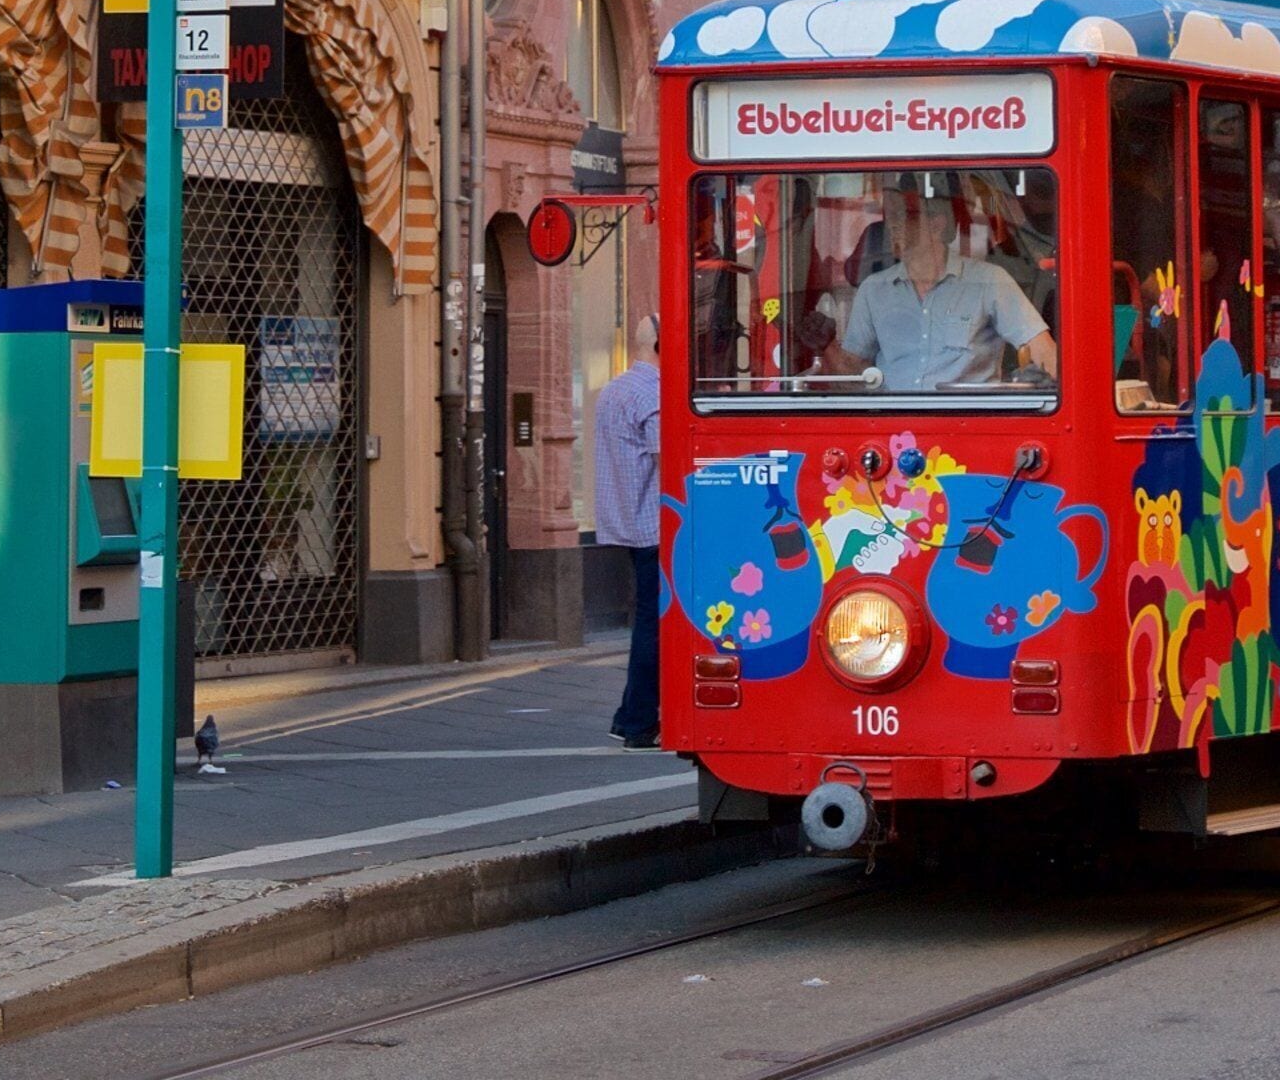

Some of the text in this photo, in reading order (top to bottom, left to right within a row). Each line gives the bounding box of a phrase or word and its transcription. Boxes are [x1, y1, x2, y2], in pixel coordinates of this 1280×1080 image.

[185, 29, 209, 51] 12
[229, 44, 271, 84] HOP
[185, 88, 222, 112] n8
[737, 96, 1027, 139] Ebbelwei-Expreß
[112, 309, 144, 329] Fahrka
[739, 451, 788, 485] VGF
[852, 705, 899, 735] 106
